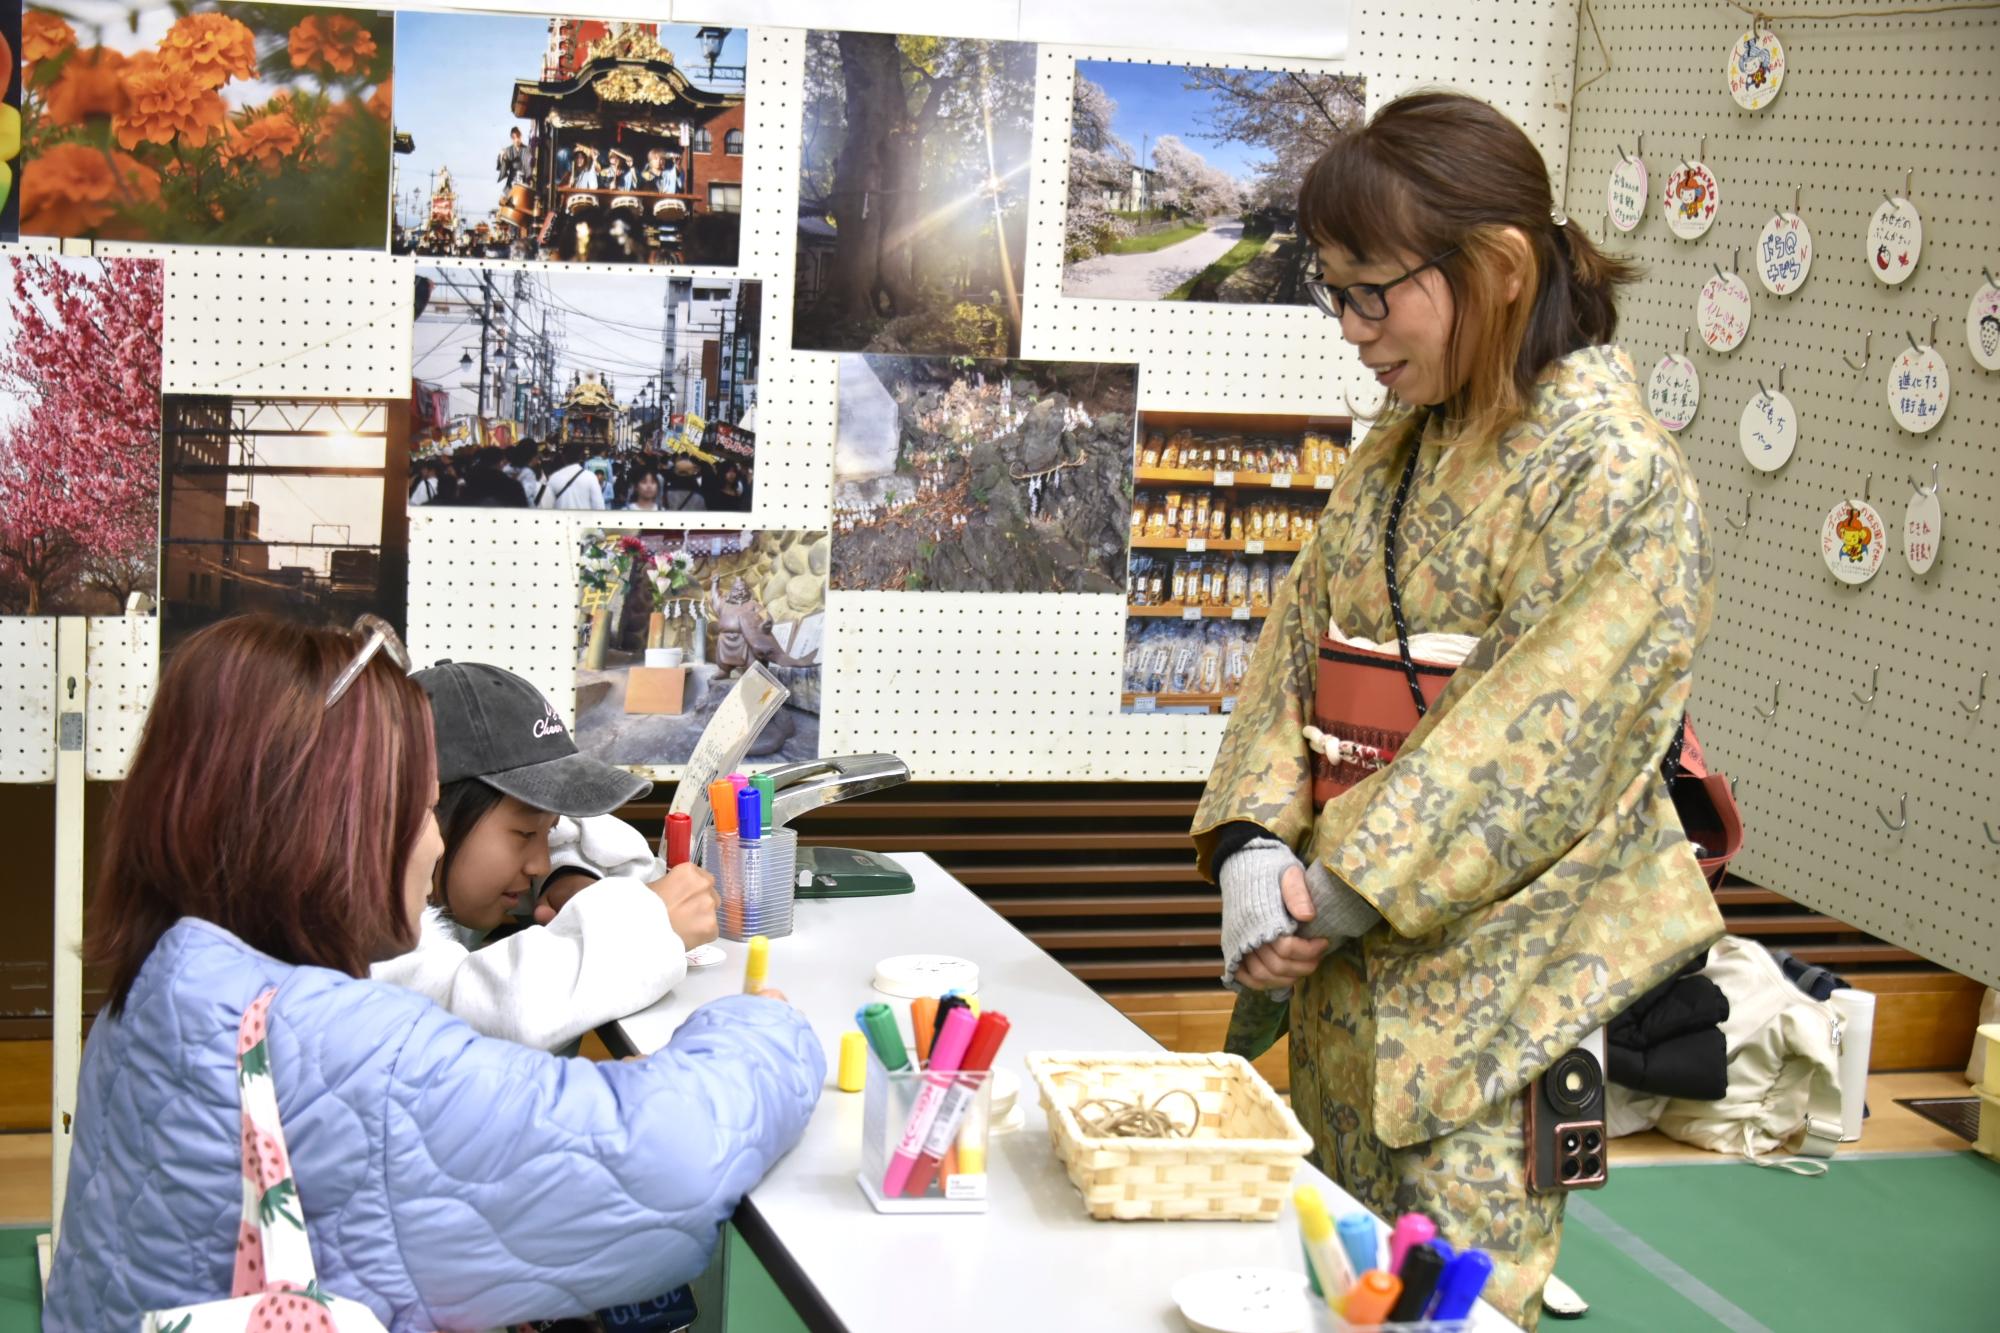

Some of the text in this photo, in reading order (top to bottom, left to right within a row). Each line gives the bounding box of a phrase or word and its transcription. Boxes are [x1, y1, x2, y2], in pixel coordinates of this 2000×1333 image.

[1656, 372, 1693, 393] かくれた
[1898, 370, 1937, 390] 進化する
